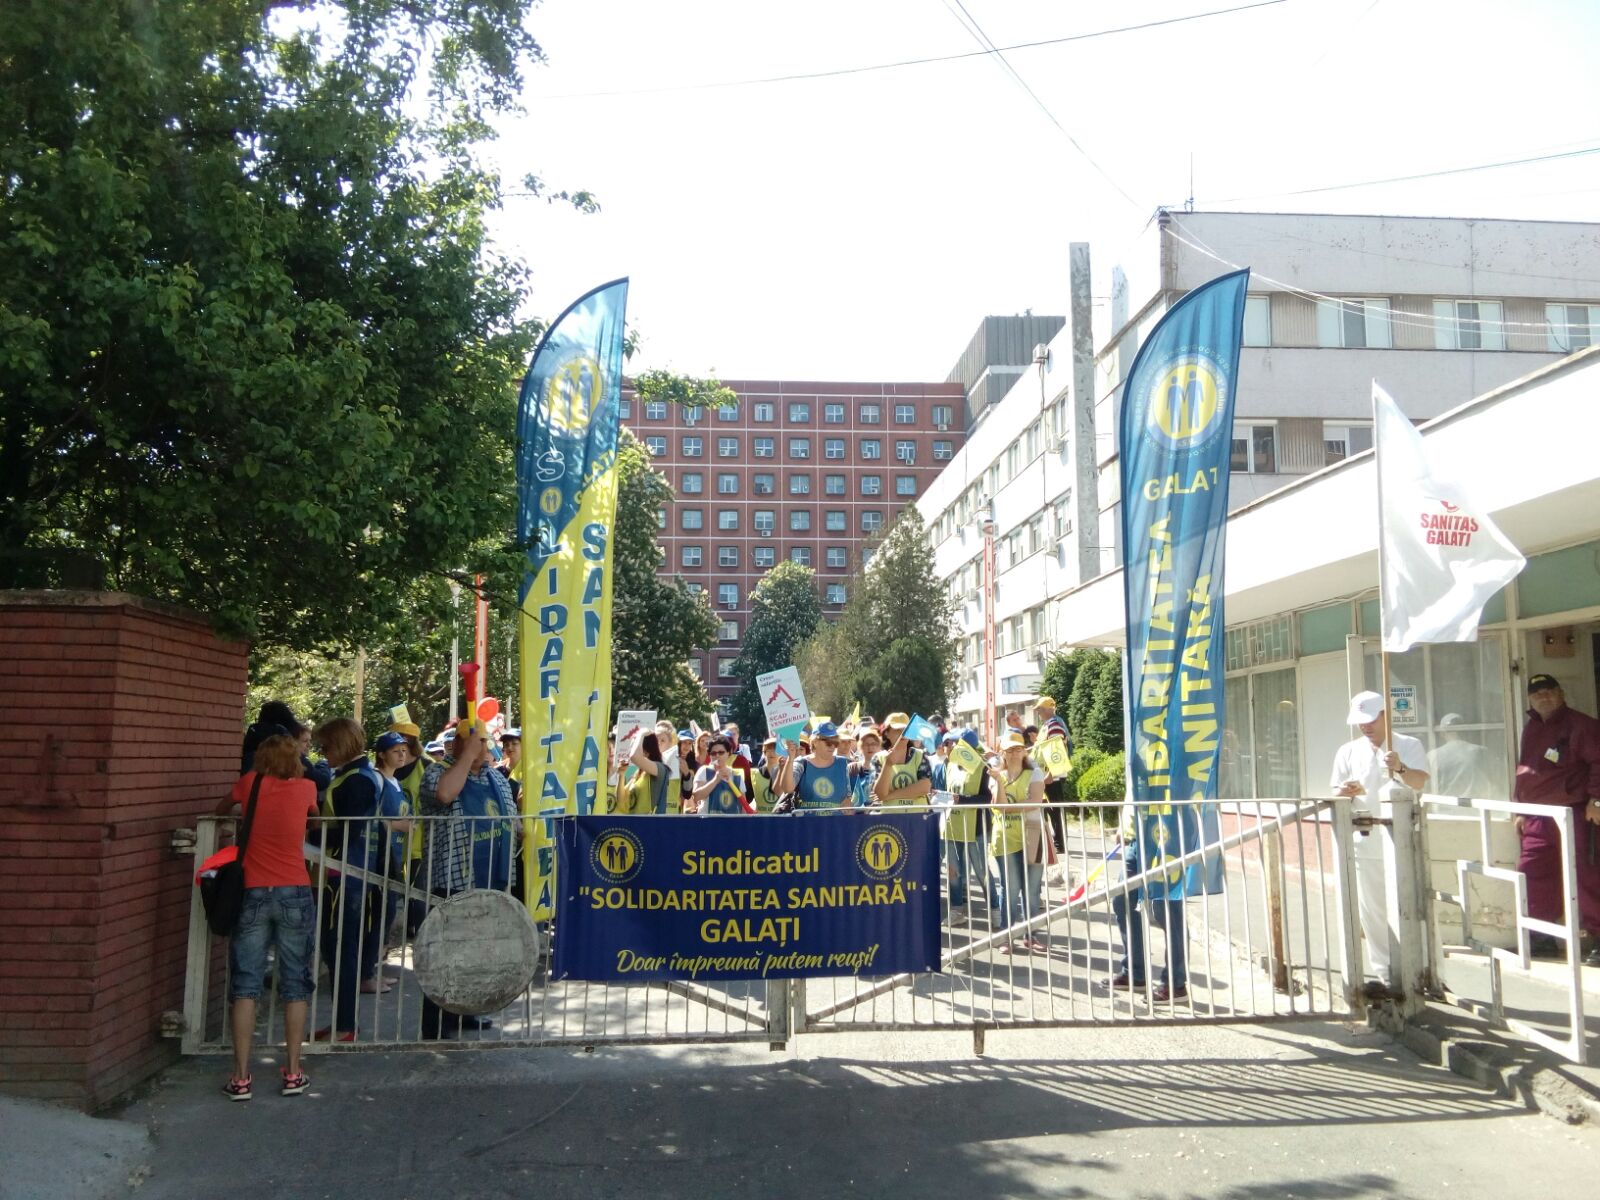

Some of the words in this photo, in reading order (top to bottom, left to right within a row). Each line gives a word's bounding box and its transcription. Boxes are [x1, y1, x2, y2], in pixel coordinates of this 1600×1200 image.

[1143, 467, 1218, 502] GALAT
[1420, 513, 1479, 533] SANITAS
[1426, 530, 1472, 547] GALATI
[682, 847, 819, 876] Sindicatul
[579, 886, 781, 911] "SOLIDARITATEA
[787, 878, 917, 909] SANITARĂ"
[700, 917, 800, 948] GALAȚI
[616, 949, 666, 973] Doar
[669, 951, 764, 980] împreună
[762, 951, 823, 979] putem
